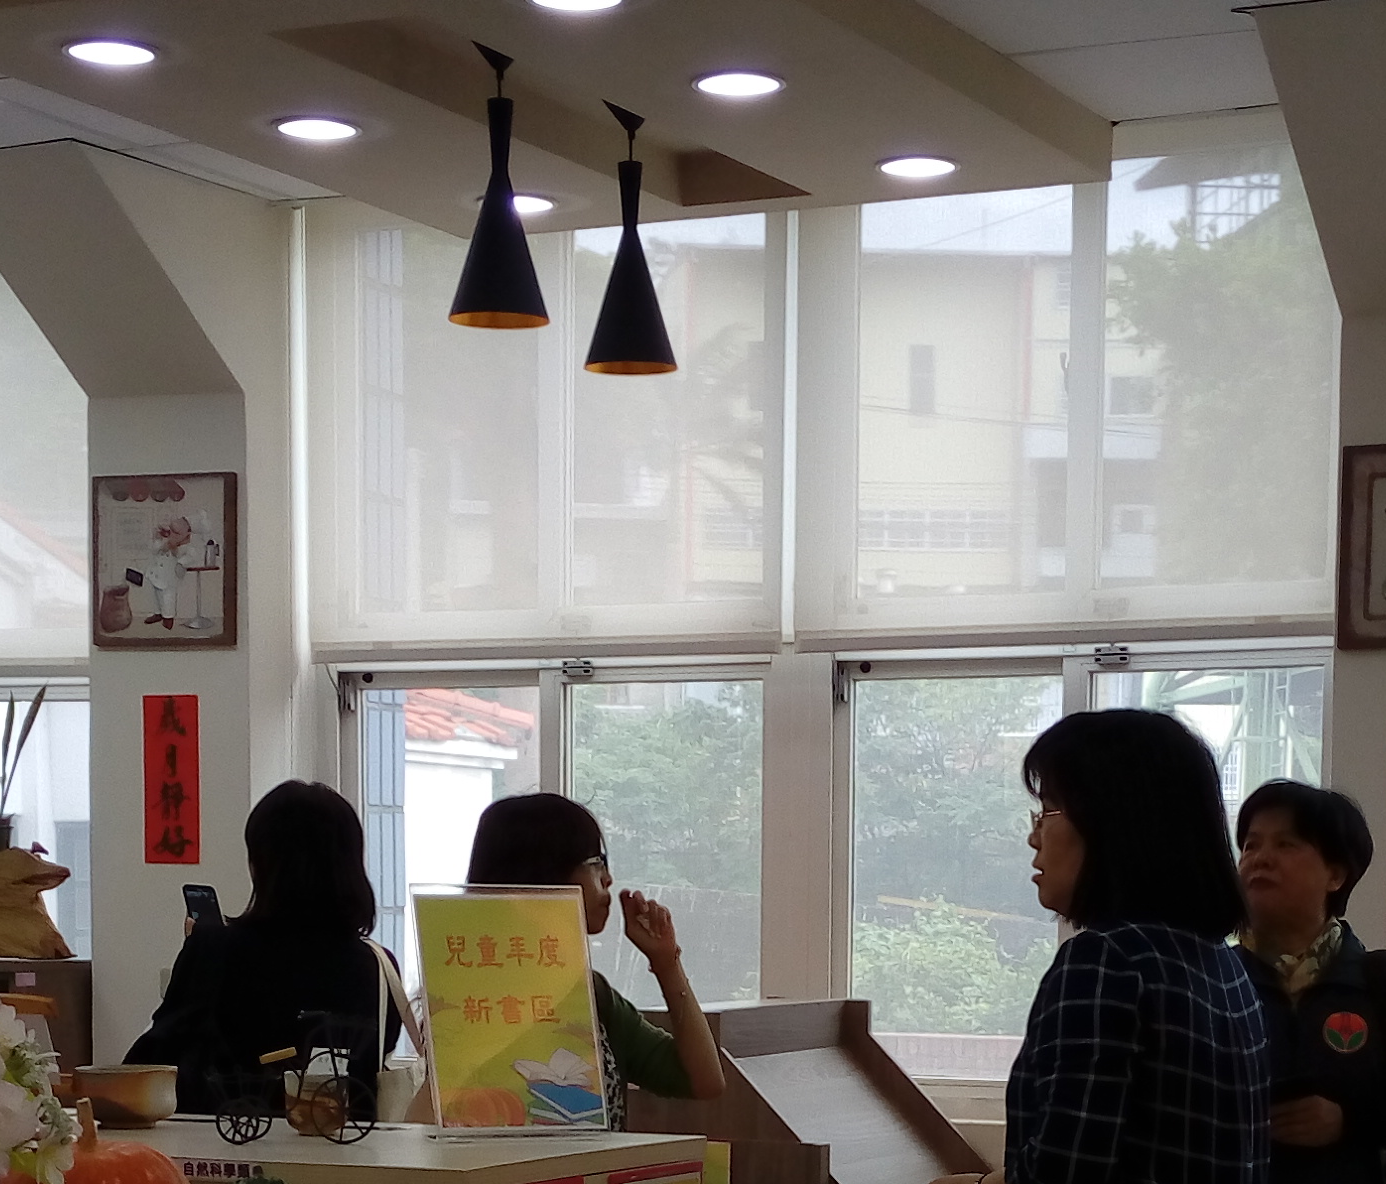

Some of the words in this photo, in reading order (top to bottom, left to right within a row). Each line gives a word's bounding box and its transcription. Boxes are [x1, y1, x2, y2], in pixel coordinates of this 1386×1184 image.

[444, 934, 567, 968] 兒童年度
[463, 994, 561, 1025] 新書區
[183, 1161, 251, 1179] 自然科學類
